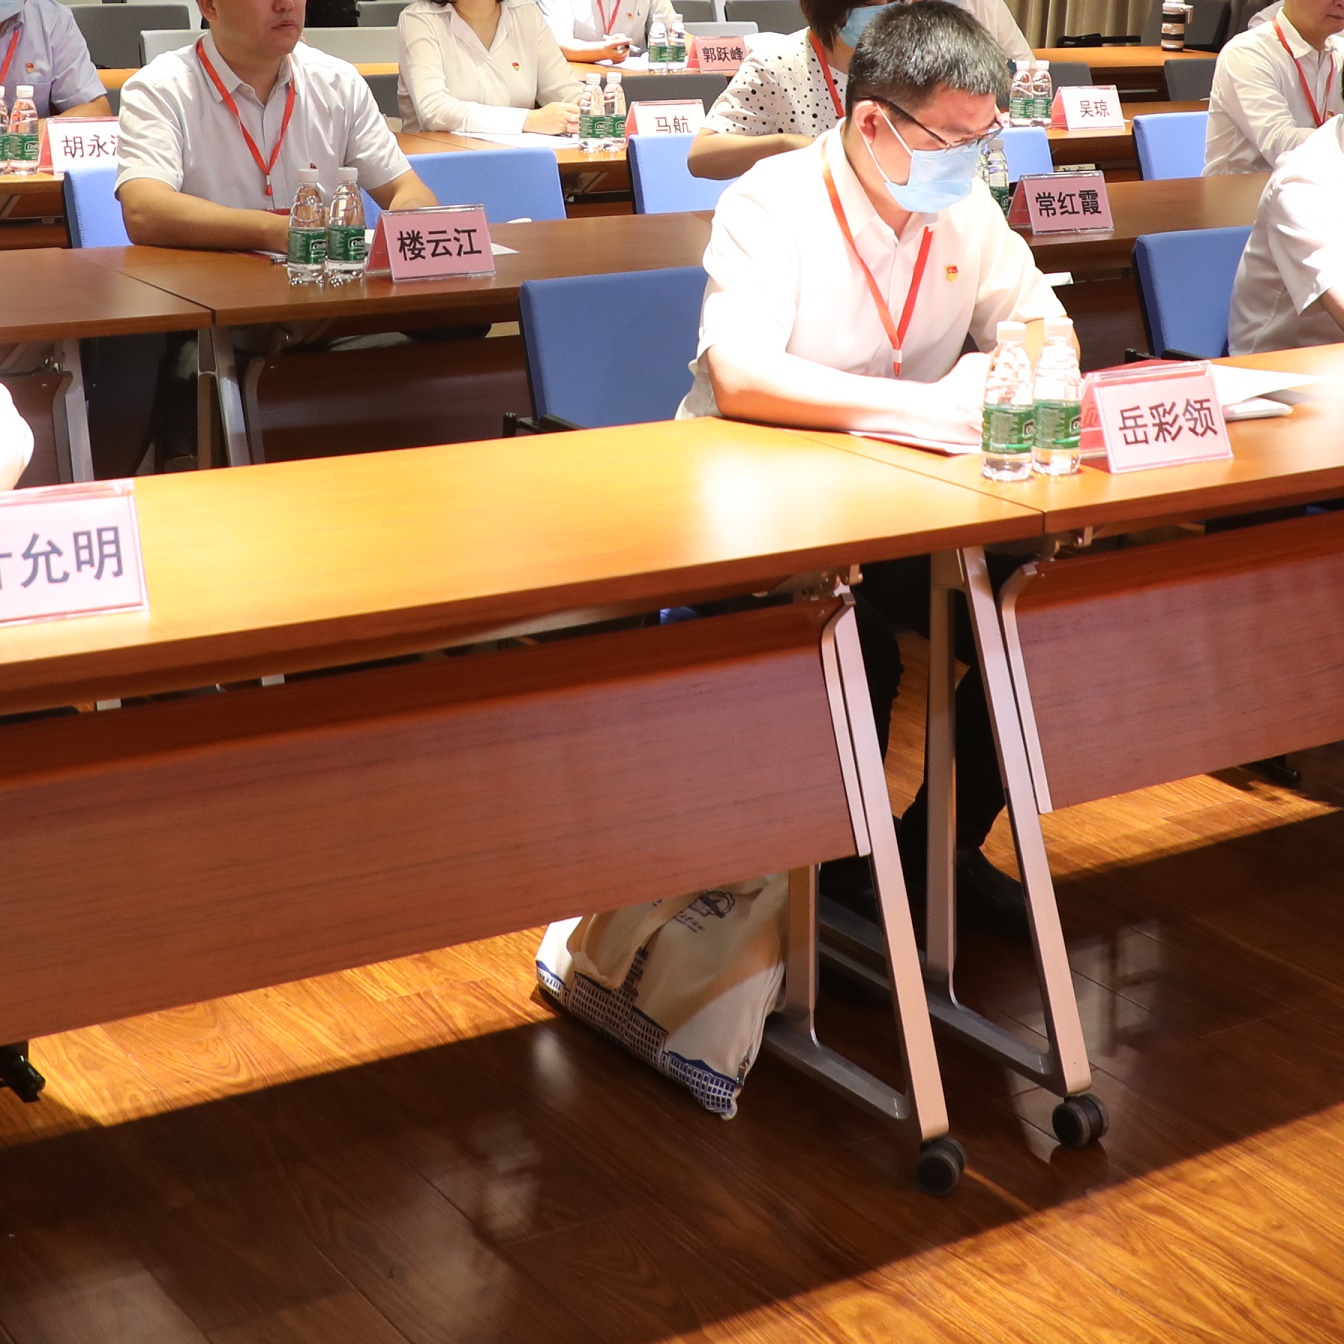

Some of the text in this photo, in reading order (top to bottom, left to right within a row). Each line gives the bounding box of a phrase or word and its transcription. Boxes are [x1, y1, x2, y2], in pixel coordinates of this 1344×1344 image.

[701, 46, 744, 63] 郭跃峰
[1079, 98, 1111, 118] 吴琼
[654, 115, 692, 134] 马航
[1034, 189, 1102, 218] 常红霞
[397, 227, 483, 262] 楼云江
[1118, 397, 1219, 447] 岳彩领
